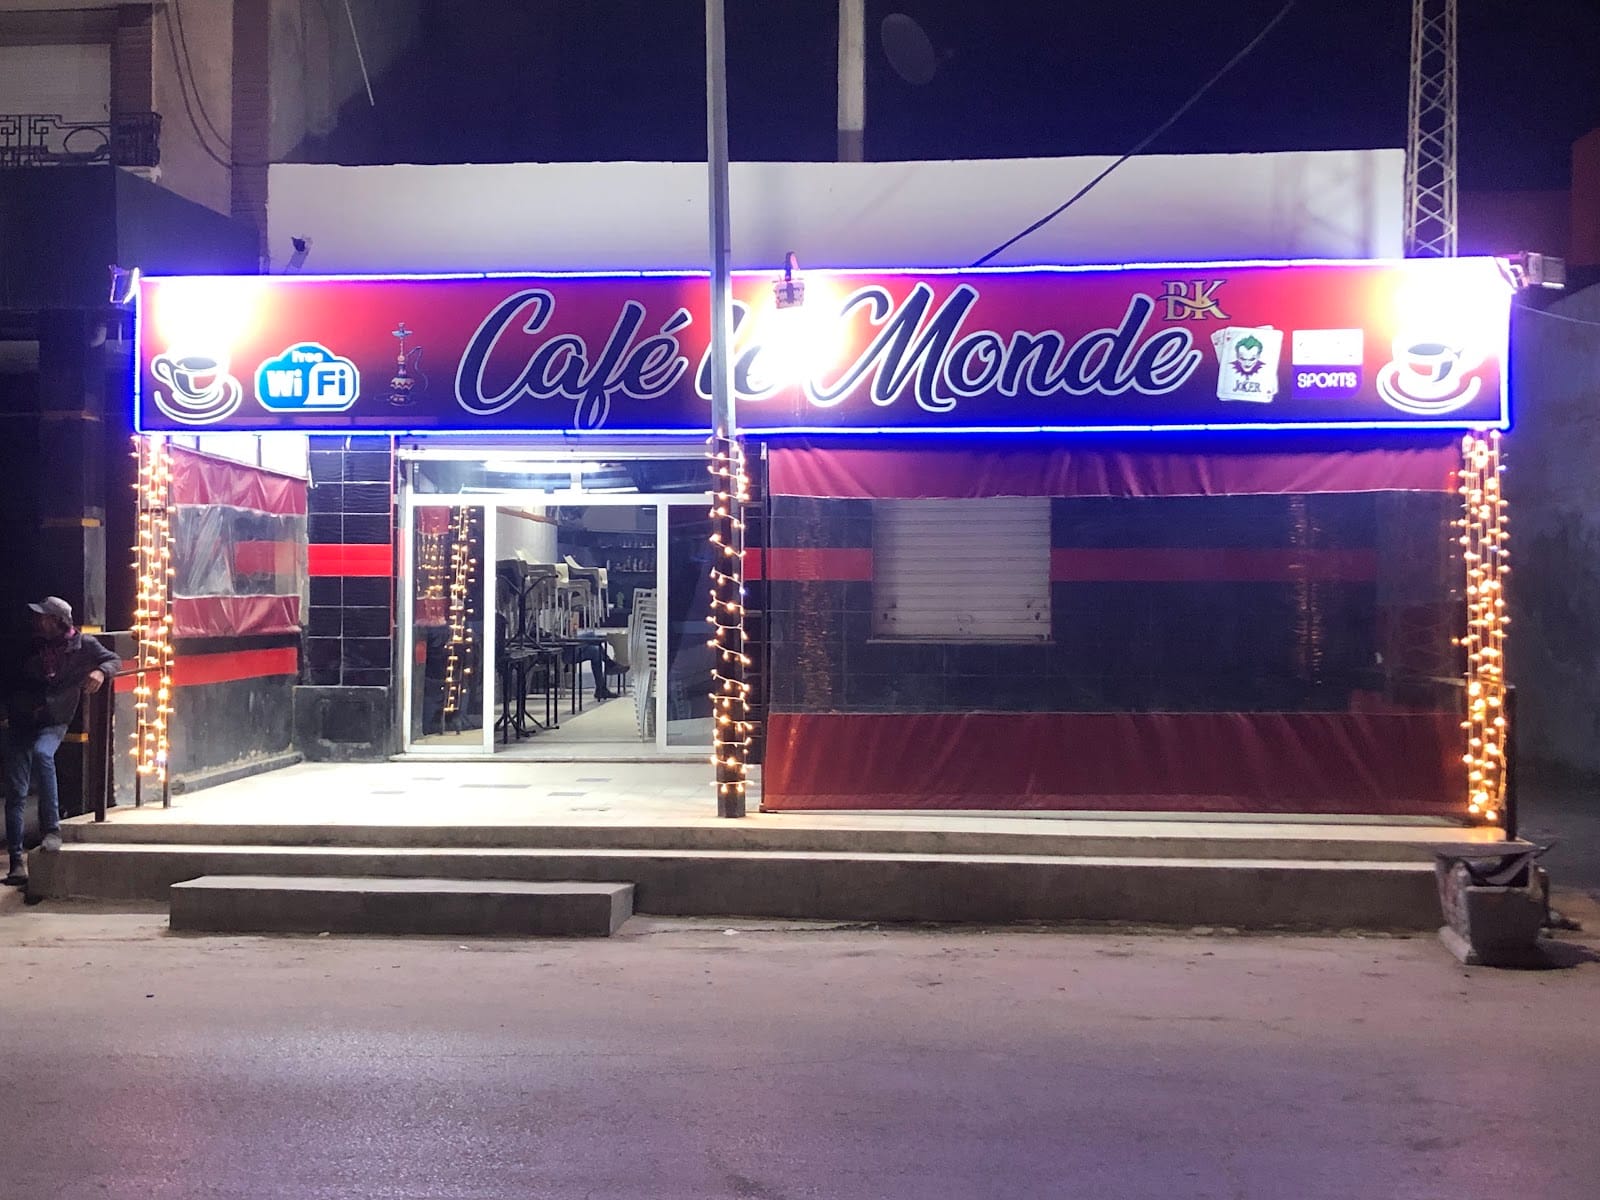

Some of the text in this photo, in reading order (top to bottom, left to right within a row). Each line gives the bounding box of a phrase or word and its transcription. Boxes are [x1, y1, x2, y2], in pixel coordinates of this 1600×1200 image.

[1155, 280, 1231, 320] BK
[455, 288, 693, 429] Café
[804, 282, 1203, 413] Monde
[1297, 372, 1357, 389] SPORTS
